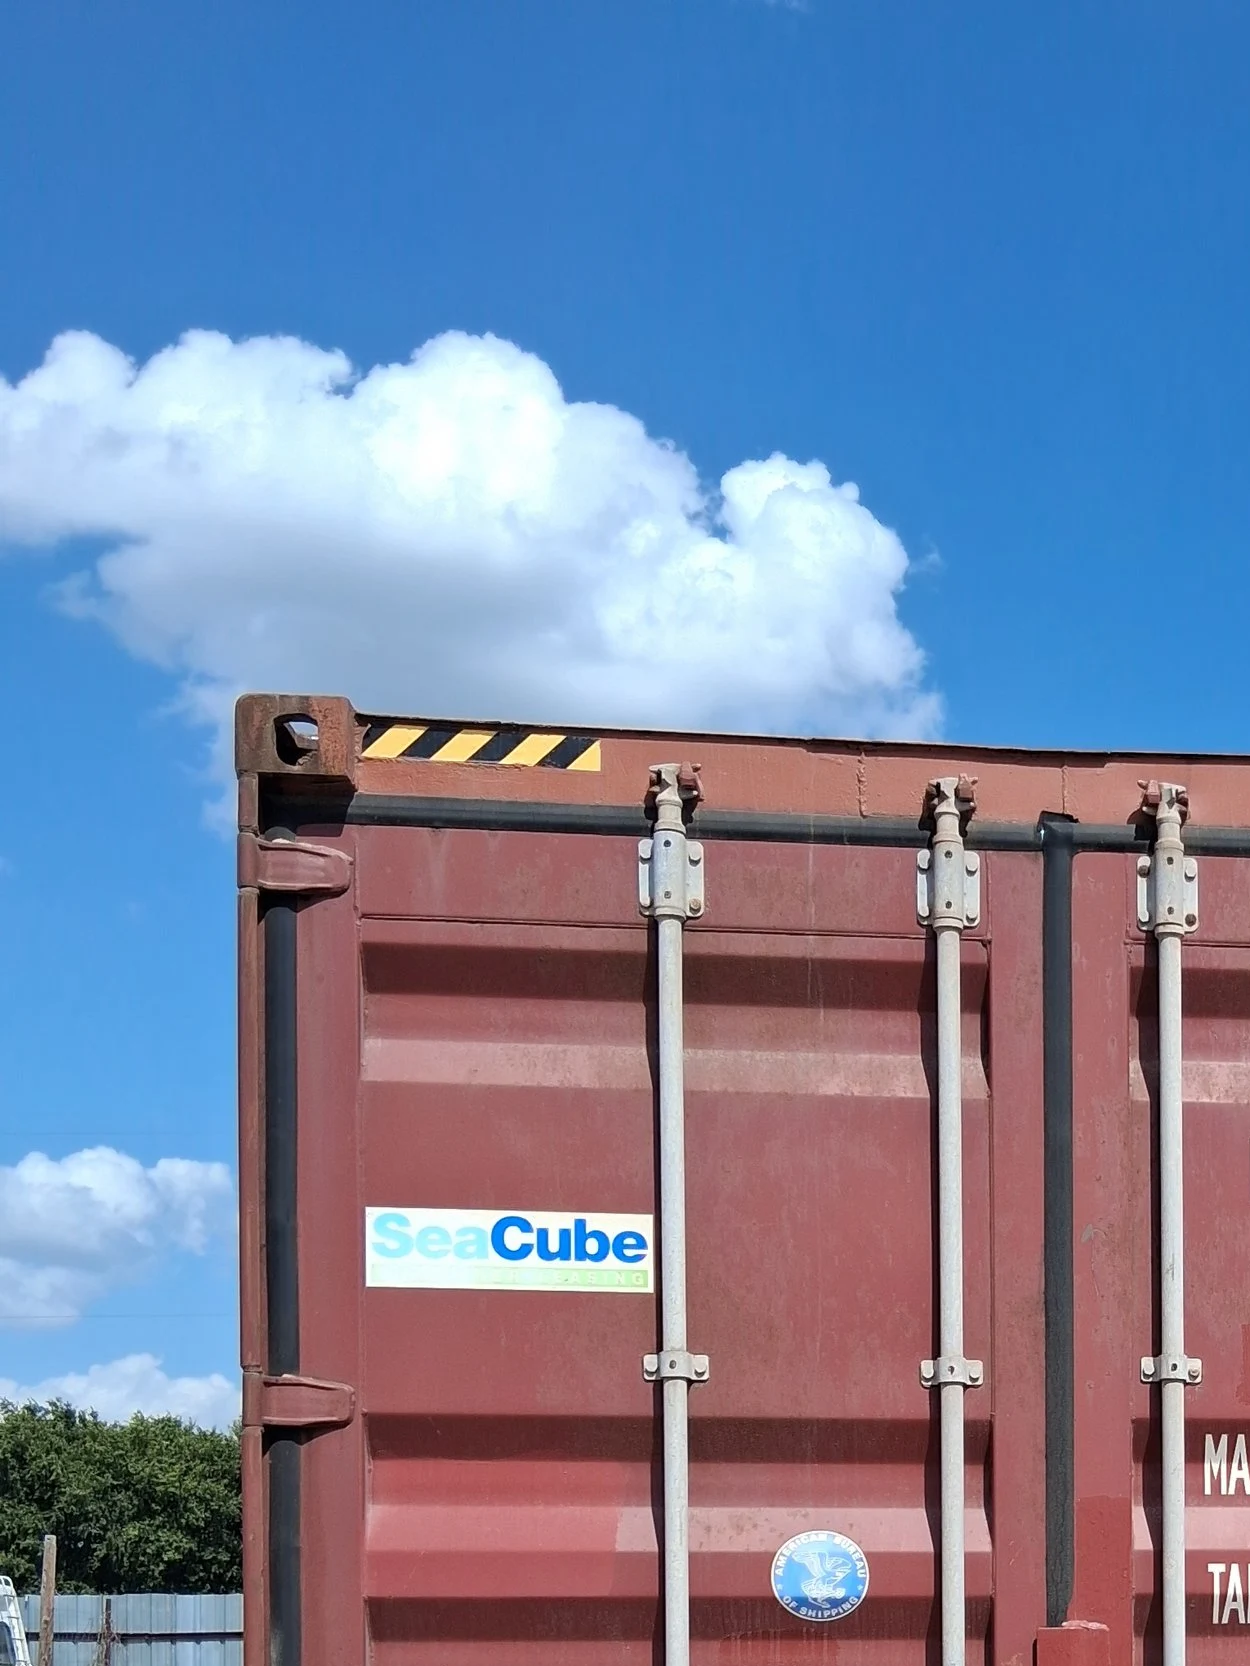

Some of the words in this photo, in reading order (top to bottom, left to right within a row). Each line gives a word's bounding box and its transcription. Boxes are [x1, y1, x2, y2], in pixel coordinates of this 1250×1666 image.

[371, 1212, 649, 1264] SeaCube
[774, 1533, 829, 1577] AMERICAN
[832, 1535, 867, 1579] BUREAU
[782, 1595, 798, 1610] OF
[799, 1595, 860, 1619] SHIPPING
